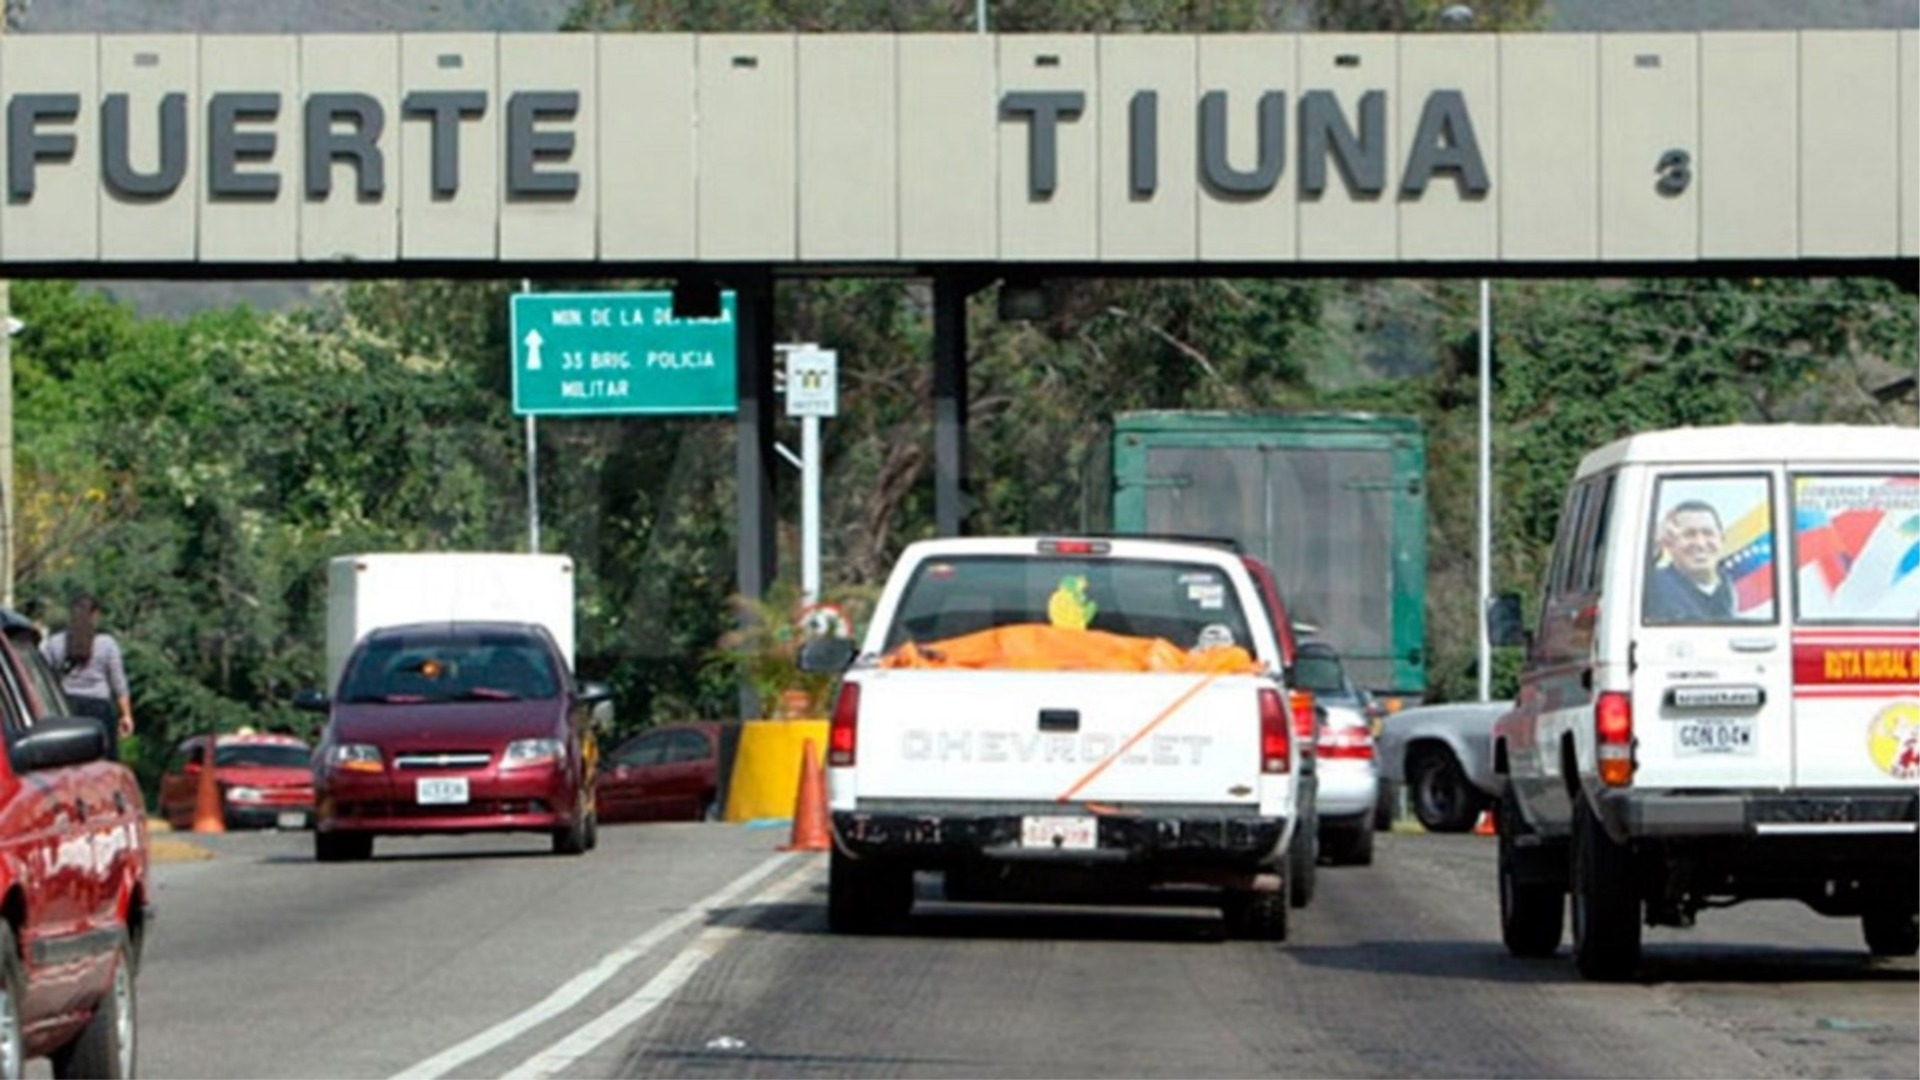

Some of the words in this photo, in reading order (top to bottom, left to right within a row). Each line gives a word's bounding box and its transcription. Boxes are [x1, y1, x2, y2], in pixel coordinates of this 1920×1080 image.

[7, 91, 581, 203] FUERTE
[1000, 89, 1490, 202] TIUNA
[591, 307, 611, 327] DE
[620, 308, 643, 327] LA
[647, 350, 716, 370] POLICIA
[561, 380, 629, 399] MILITAR
